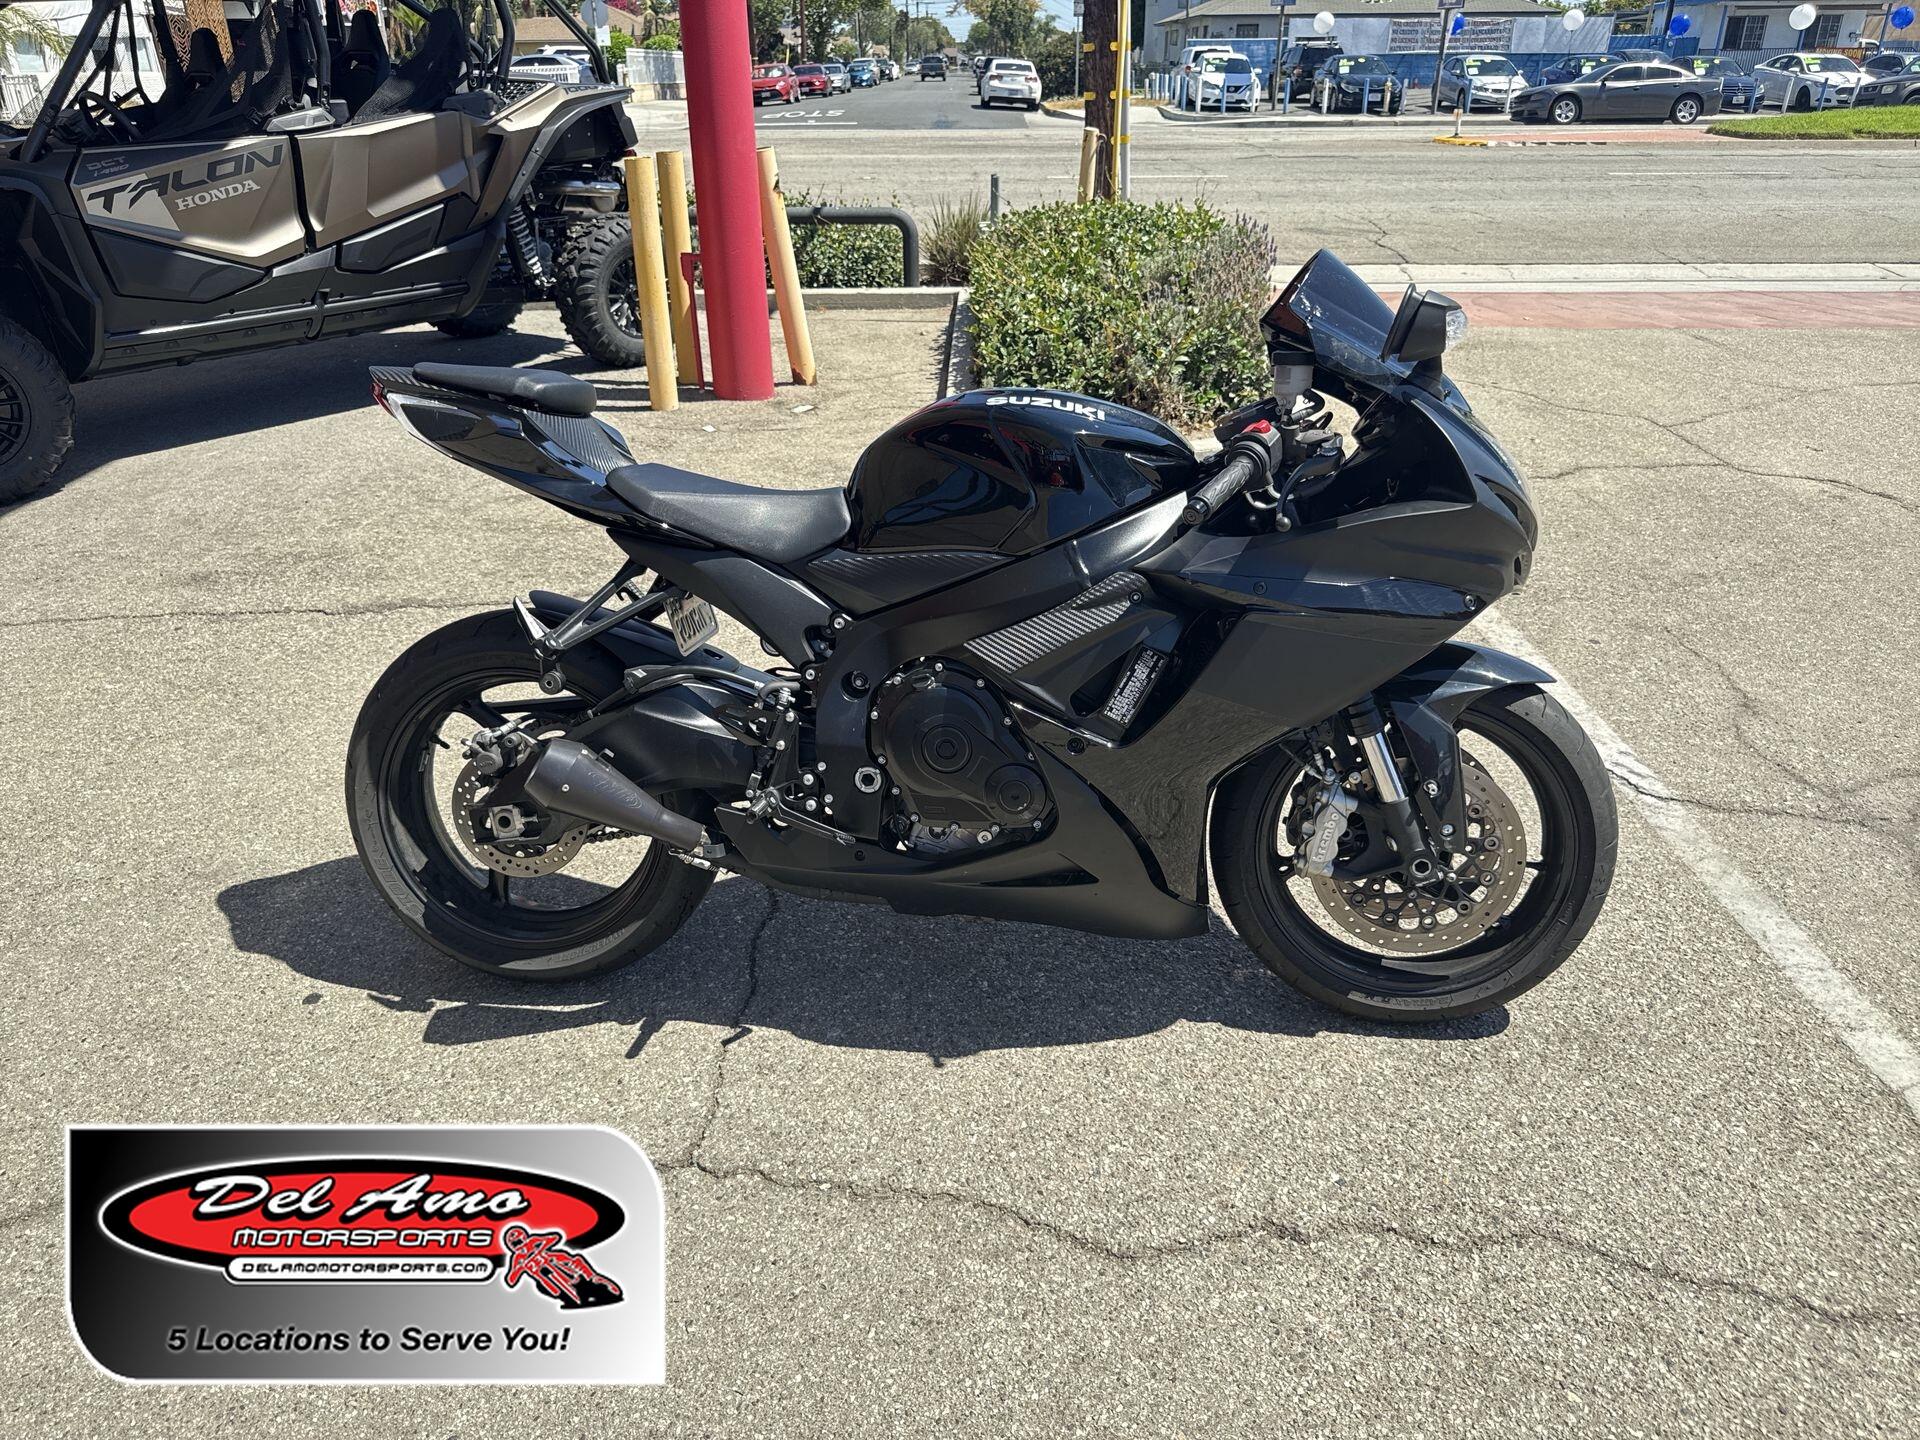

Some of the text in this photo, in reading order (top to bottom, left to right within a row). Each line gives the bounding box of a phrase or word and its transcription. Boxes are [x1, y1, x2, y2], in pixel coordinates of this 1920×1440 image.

[1843, 48, 1863, 59] SOON
[761, 109, 846, 119] STOP
[86, 156, 126, 171] DCT
[87, 144, 284, 214] TALON
[174, 179, 261, 211] HONDA
[986, 396, 1106, 421] SUZUKI
[1312, 812, 1340, 863] brembo
